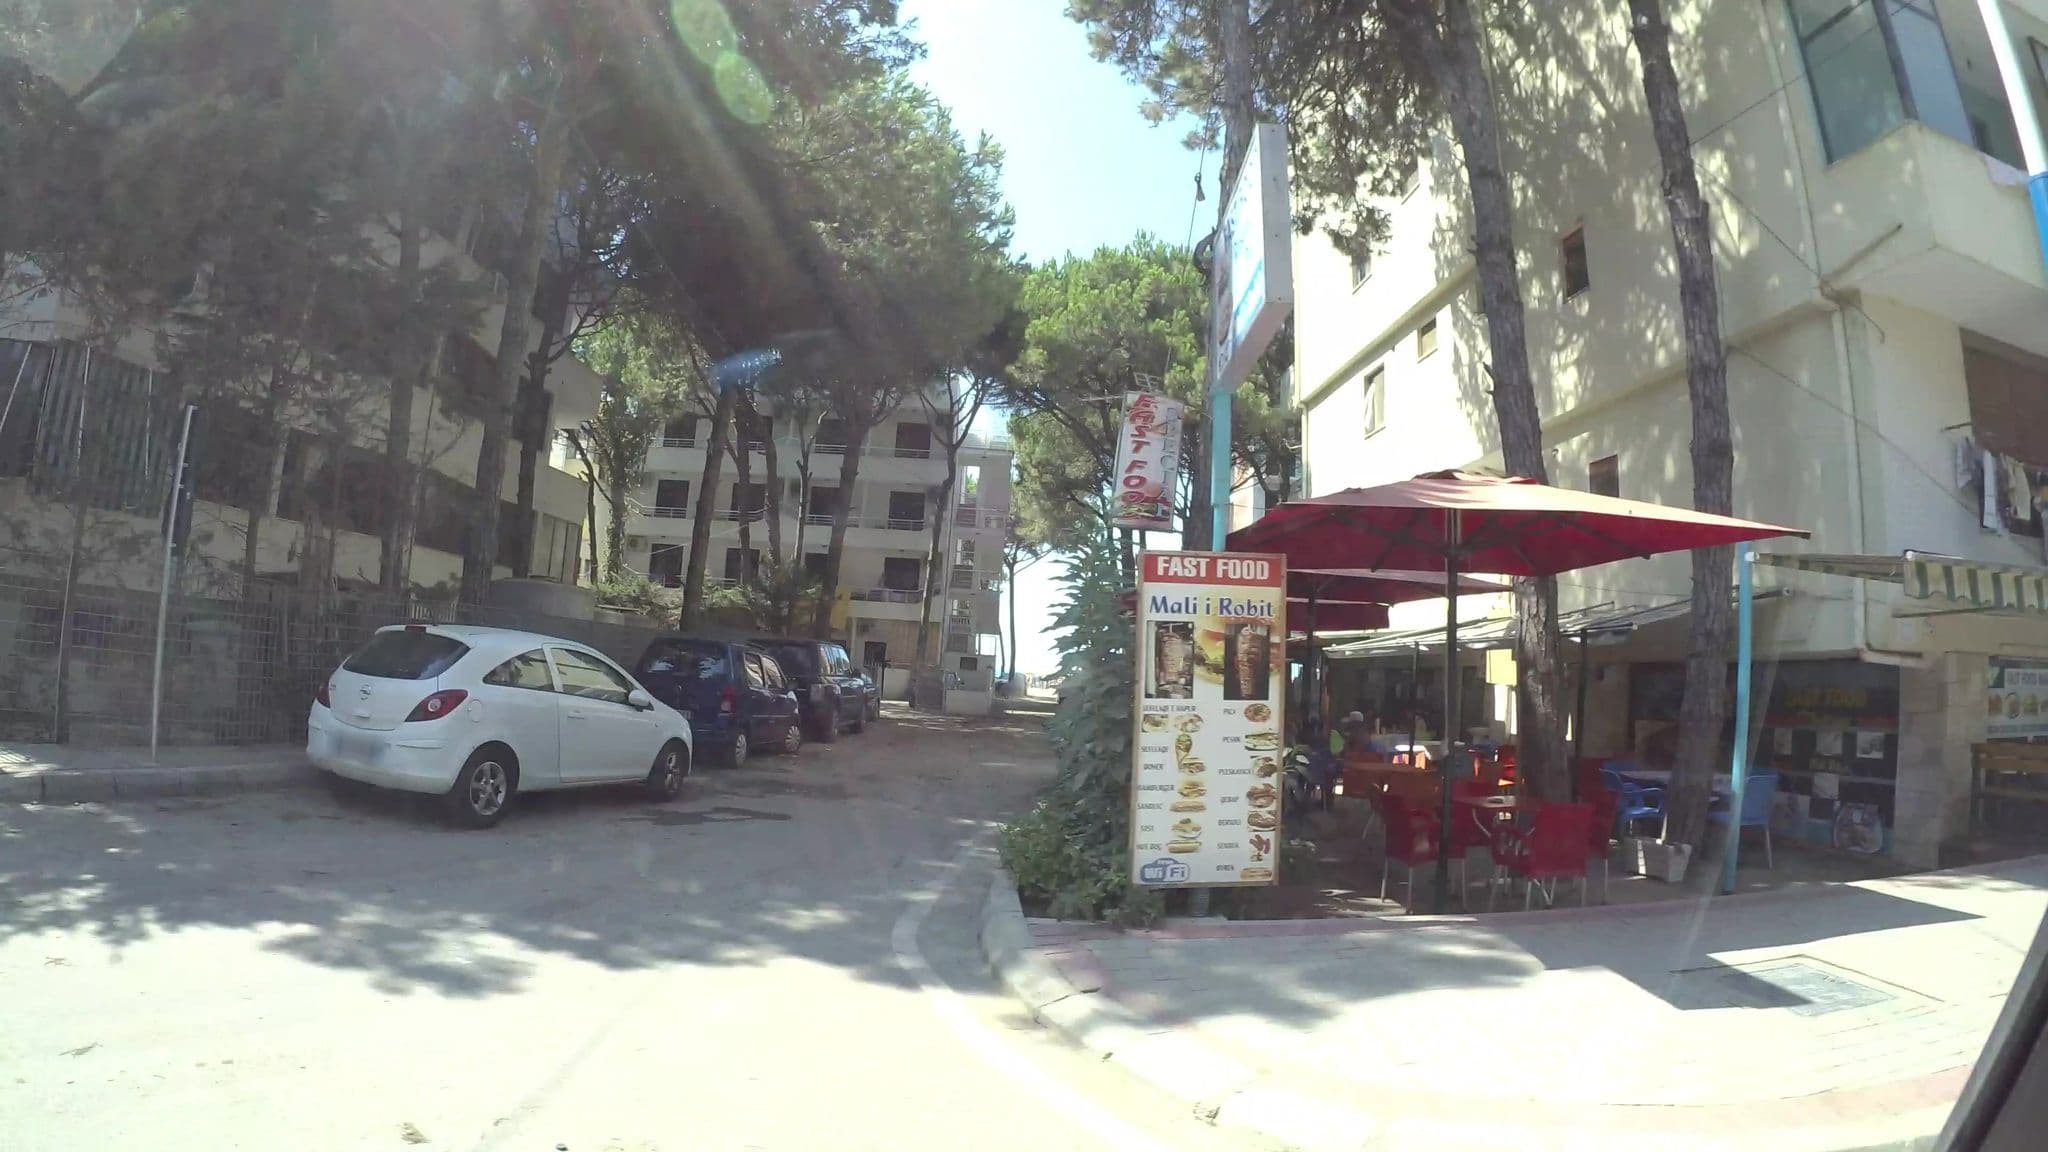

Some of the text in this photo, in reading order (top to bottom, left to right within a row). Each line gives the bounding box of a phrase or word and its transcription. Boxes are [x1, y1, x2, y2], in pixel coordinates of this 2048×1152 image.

[1157, 556, 1269, 580] FAST FOOD
[1150, 596, 1273, 617] Mali i Robit
